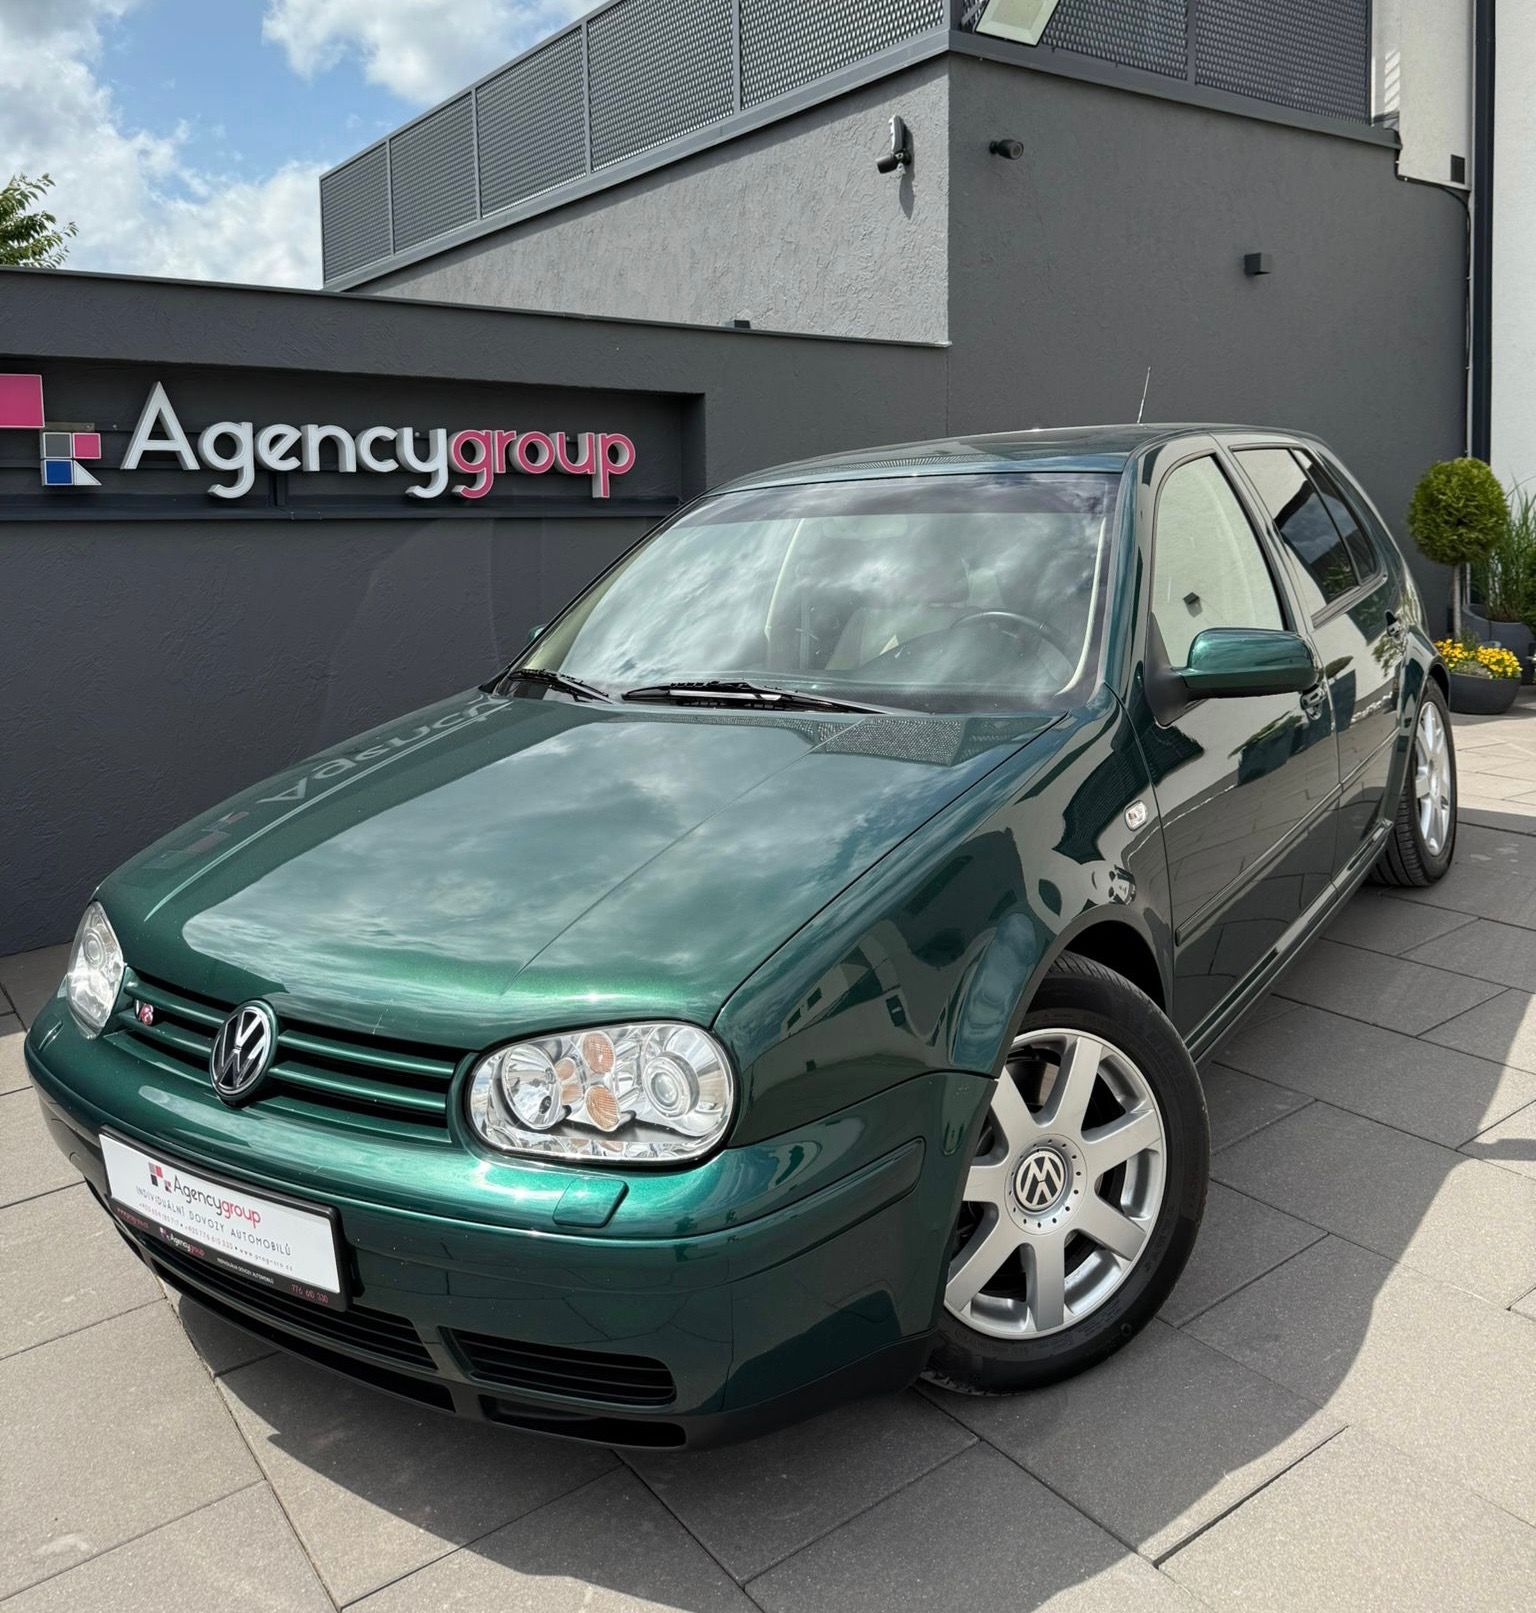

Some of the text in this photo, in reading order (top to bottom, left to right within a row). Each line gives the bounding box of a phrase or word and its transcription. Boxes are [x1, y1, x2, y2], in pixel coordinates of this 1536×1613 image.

[120, 380, 636, 499] Agencygroup
[212, 1005, 270, 1094] VW
[173, 1175, 261, 1229] Agencygroup
[188, 1209, 225, 1233] DOVOZY
[230, 1227, 292, 1256] AUTOMOBILŮ
